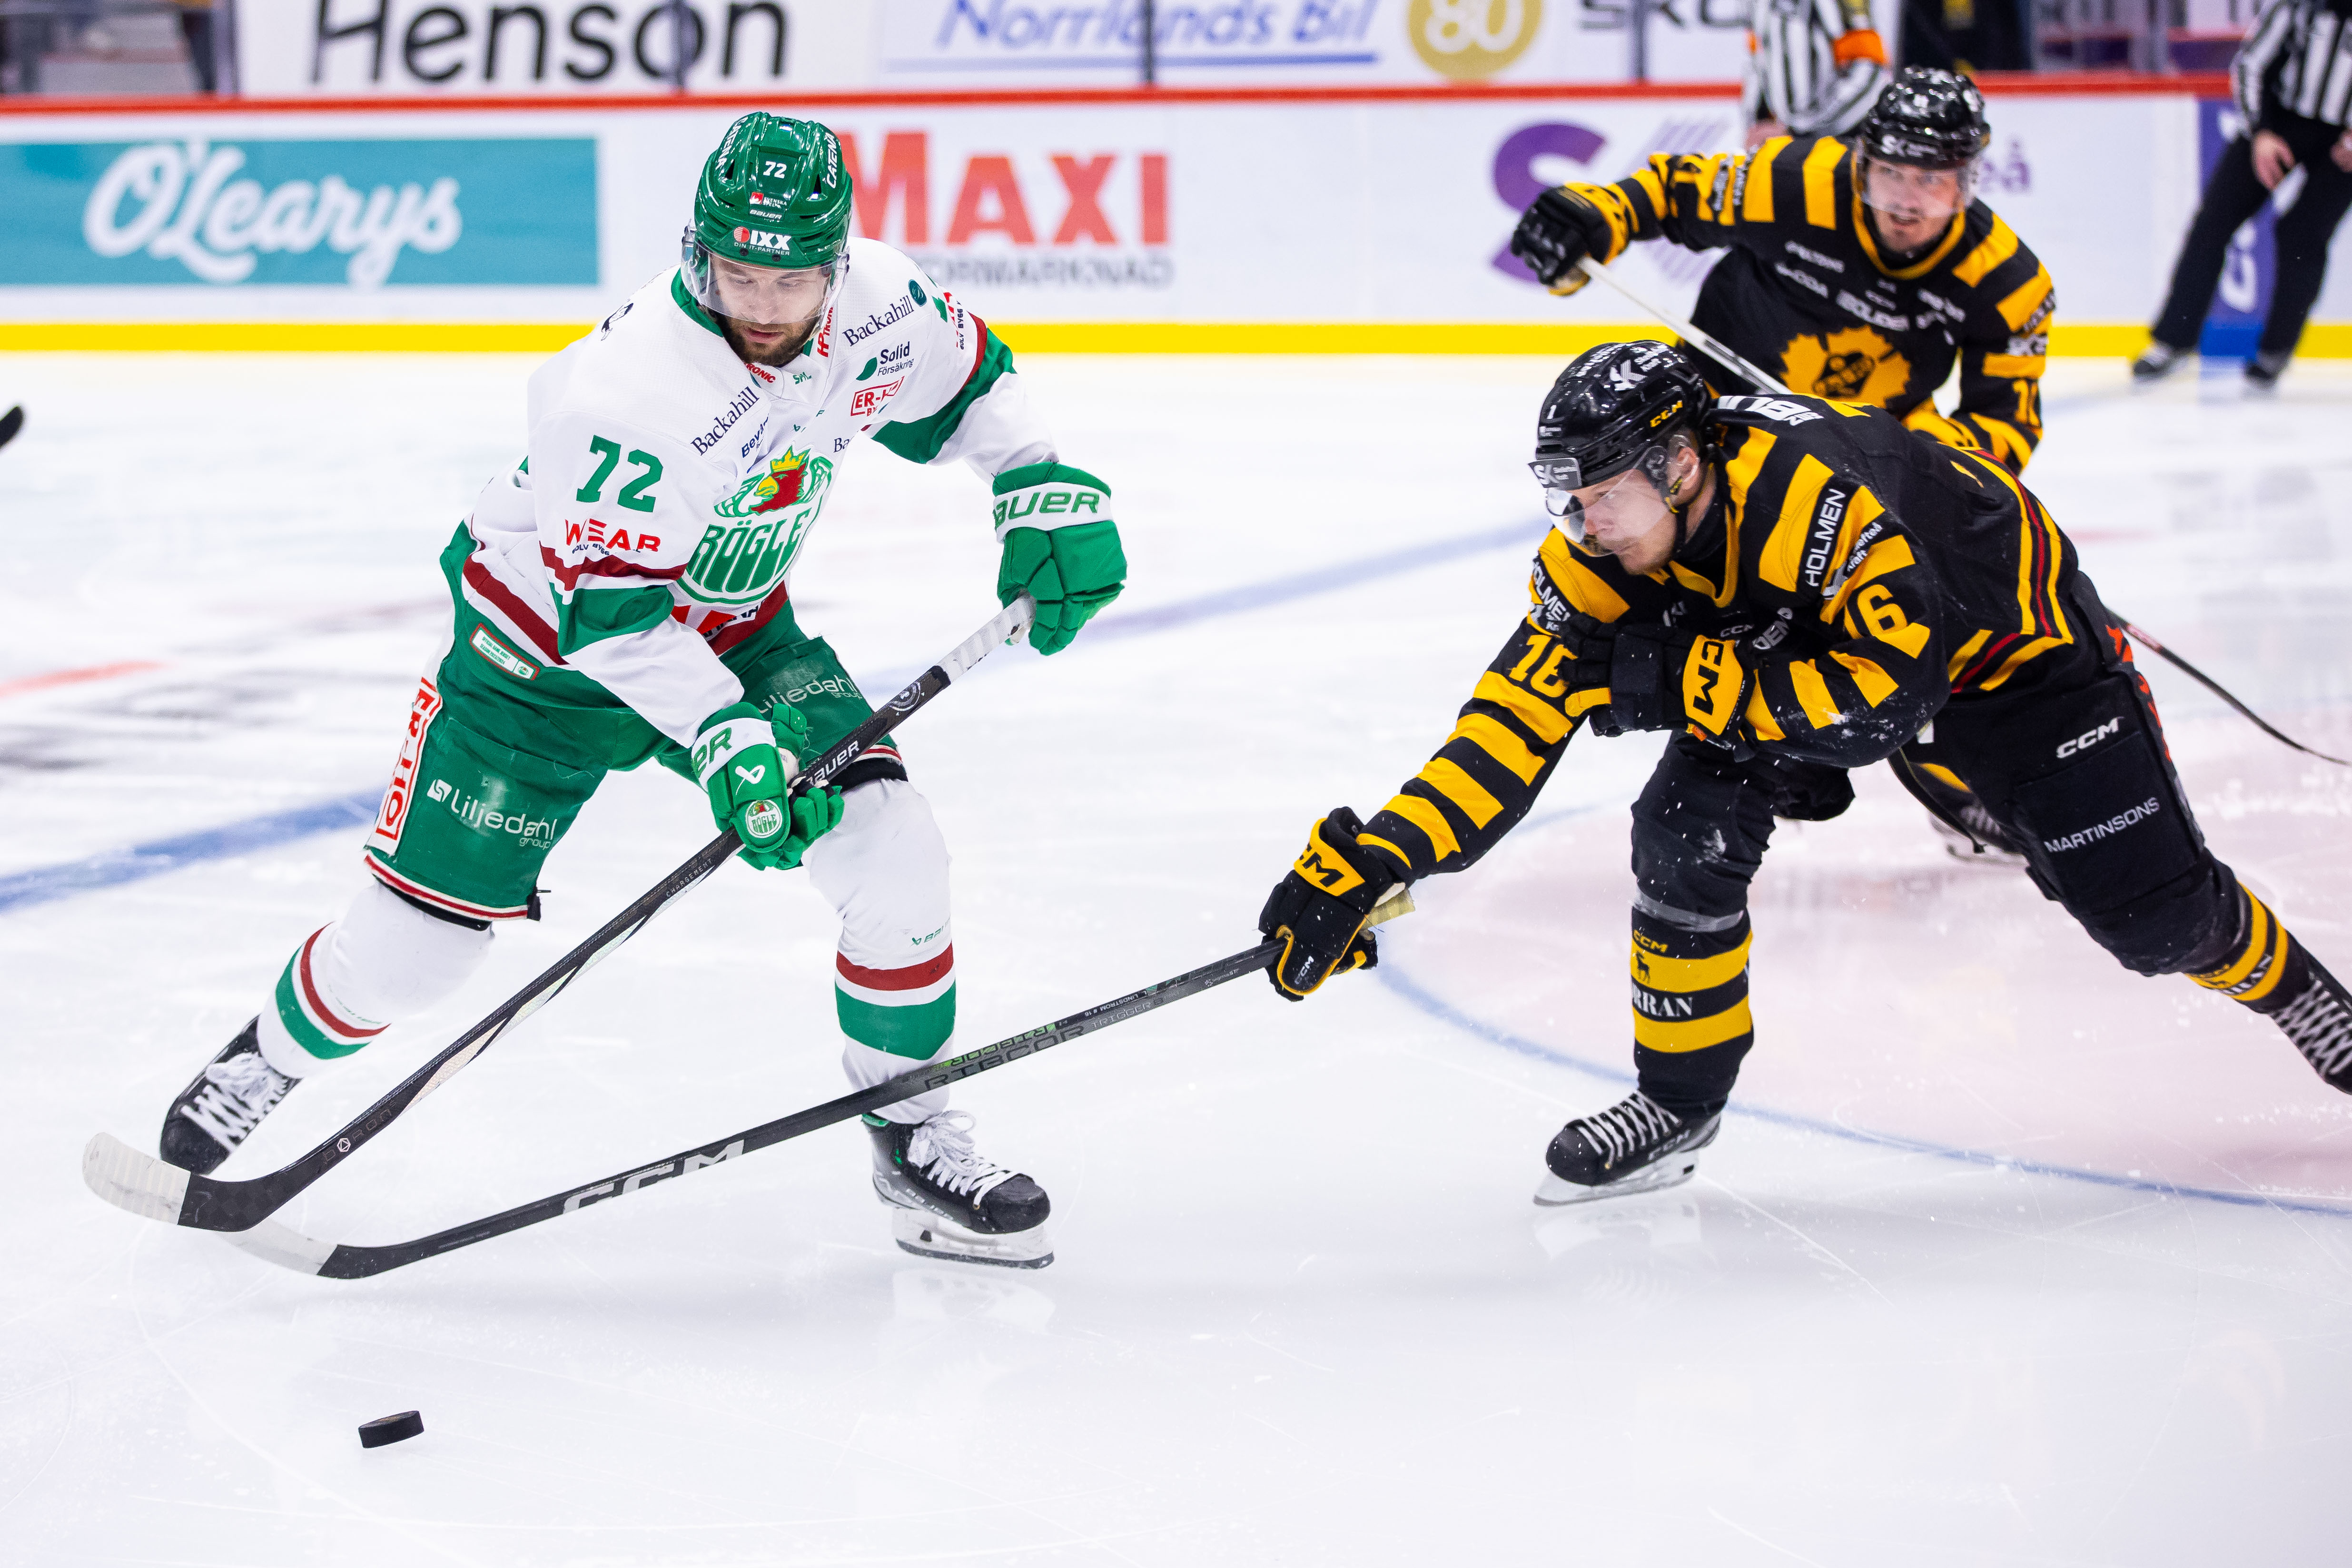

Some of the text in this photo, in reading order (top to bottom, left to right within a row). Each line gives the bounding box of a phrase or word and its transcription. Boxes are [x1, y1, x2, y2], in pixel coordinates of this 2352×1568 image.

[309, 0, 788, 83] Henson
[762, 160, 787, 179] 72
[824, 132, 838, 188] CATENA
[840, 129, 1170, 246] MAXI
[83, 136, 463, 289] O'Learys
[749, 245, 790, 256] IT-PARTNER
[842, 296, 914, 347] Backahill
[743, 362, 776, 384] RONIC
[878, 358, 914, 376] Försäkring
[880, 341, 910, 365] Solid
[691, 385, 760, 456] Backahill
[576, 434, 663, 513] 72
[565, 518, 661, 552] WEAR
[685, 508, 812, 592] RÖGLE
[1805, 488, 1846, 587] HOLMEN
[2056, 716, 2125, 759] CCM
[451, 789, 557, 840] Liljedahl
[2044, 797, 2161, 854] MARTINSONS
[519, 837, 552, 850] group
[666, 858, 713, 897] CHARGEMENT
[1633, 930, 1668, 953] CCM
[1100, 992, 1139, 1012] LINDSTROM
